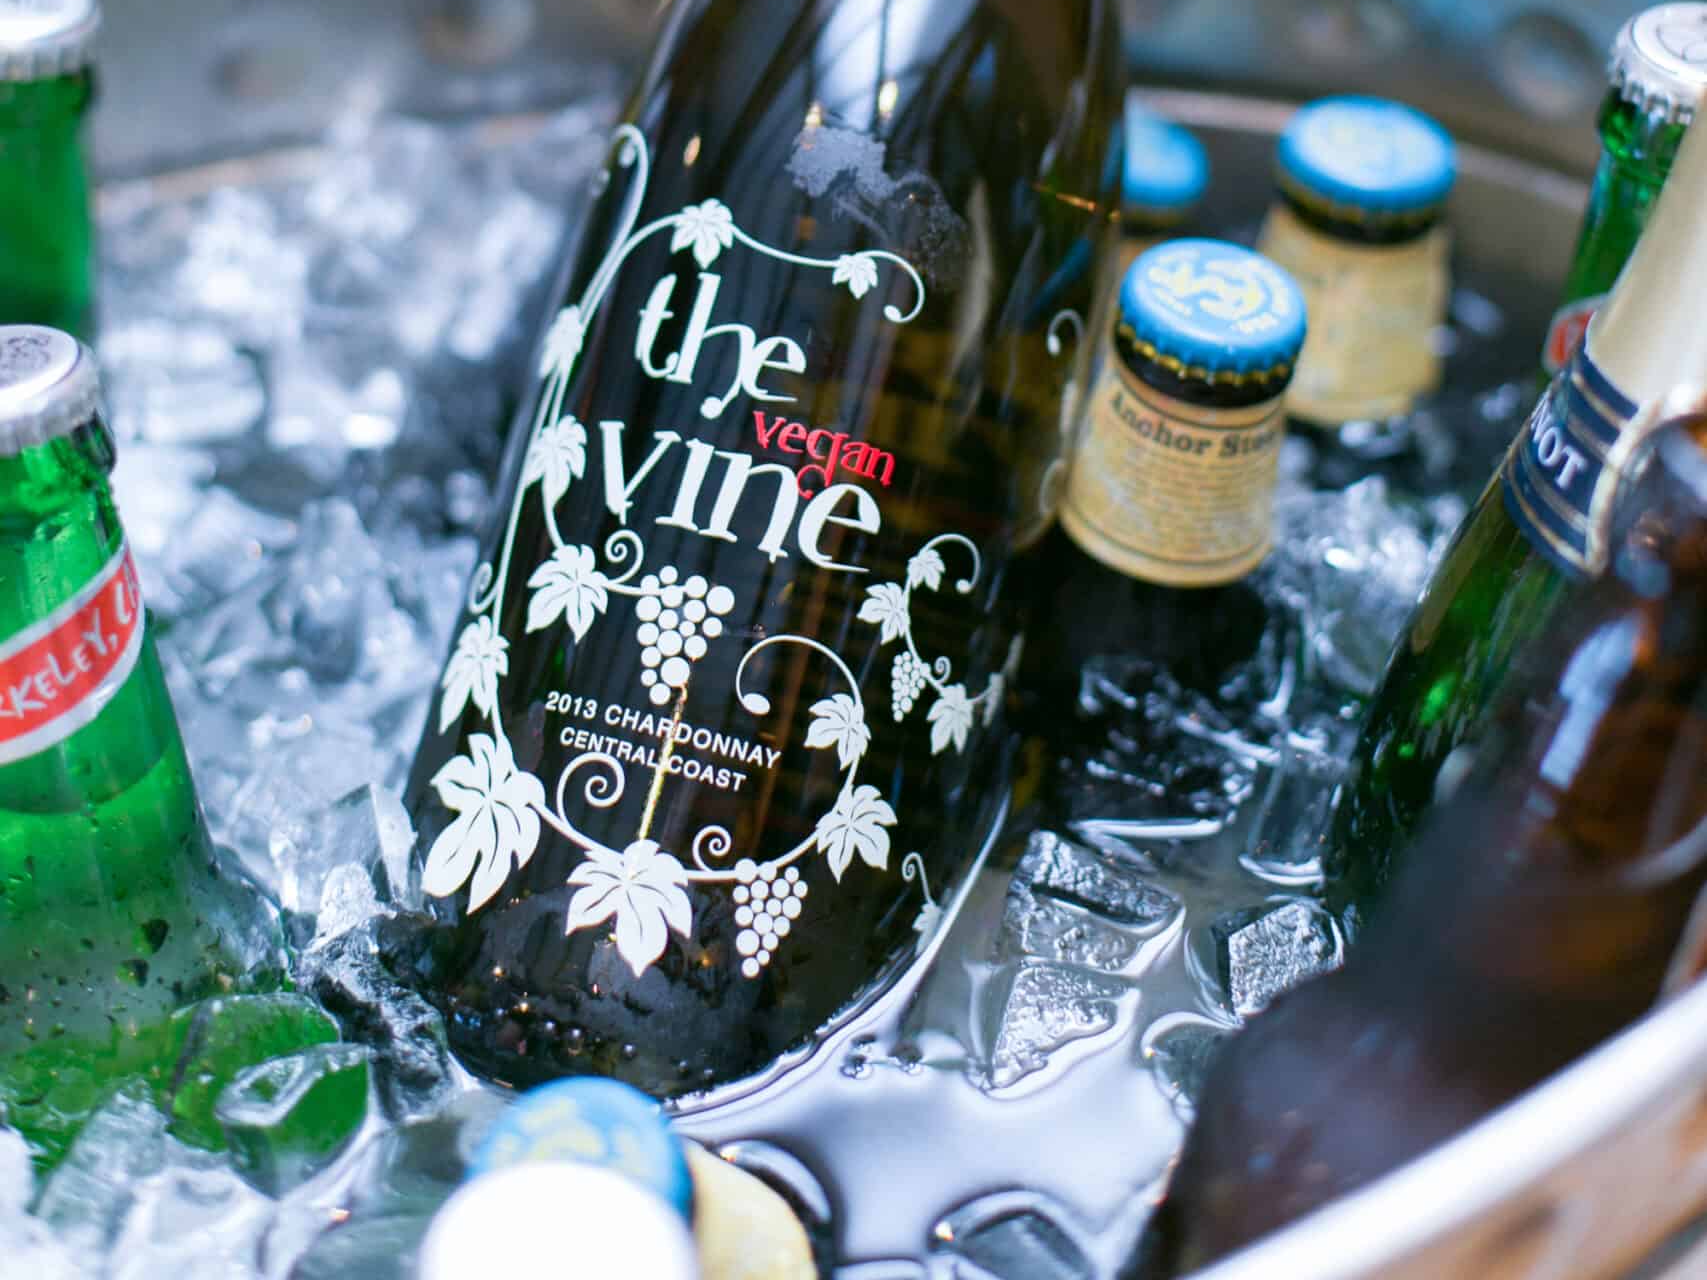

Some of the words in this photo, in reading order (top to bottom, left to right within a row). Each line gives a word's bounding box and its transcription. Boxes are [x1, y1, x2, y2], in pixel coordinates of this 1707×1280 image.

[634, 272, 807, 419] the
[600, 420, 882, 573] vine
[752, 410, 895, 500] vegan
[544, 690, 599, 720] 2013
[603, 704, 782, 770] CHARDONNAY
[559, 726, 660, 770] CENTRAL
[667, 754, 747, 793] COAST
